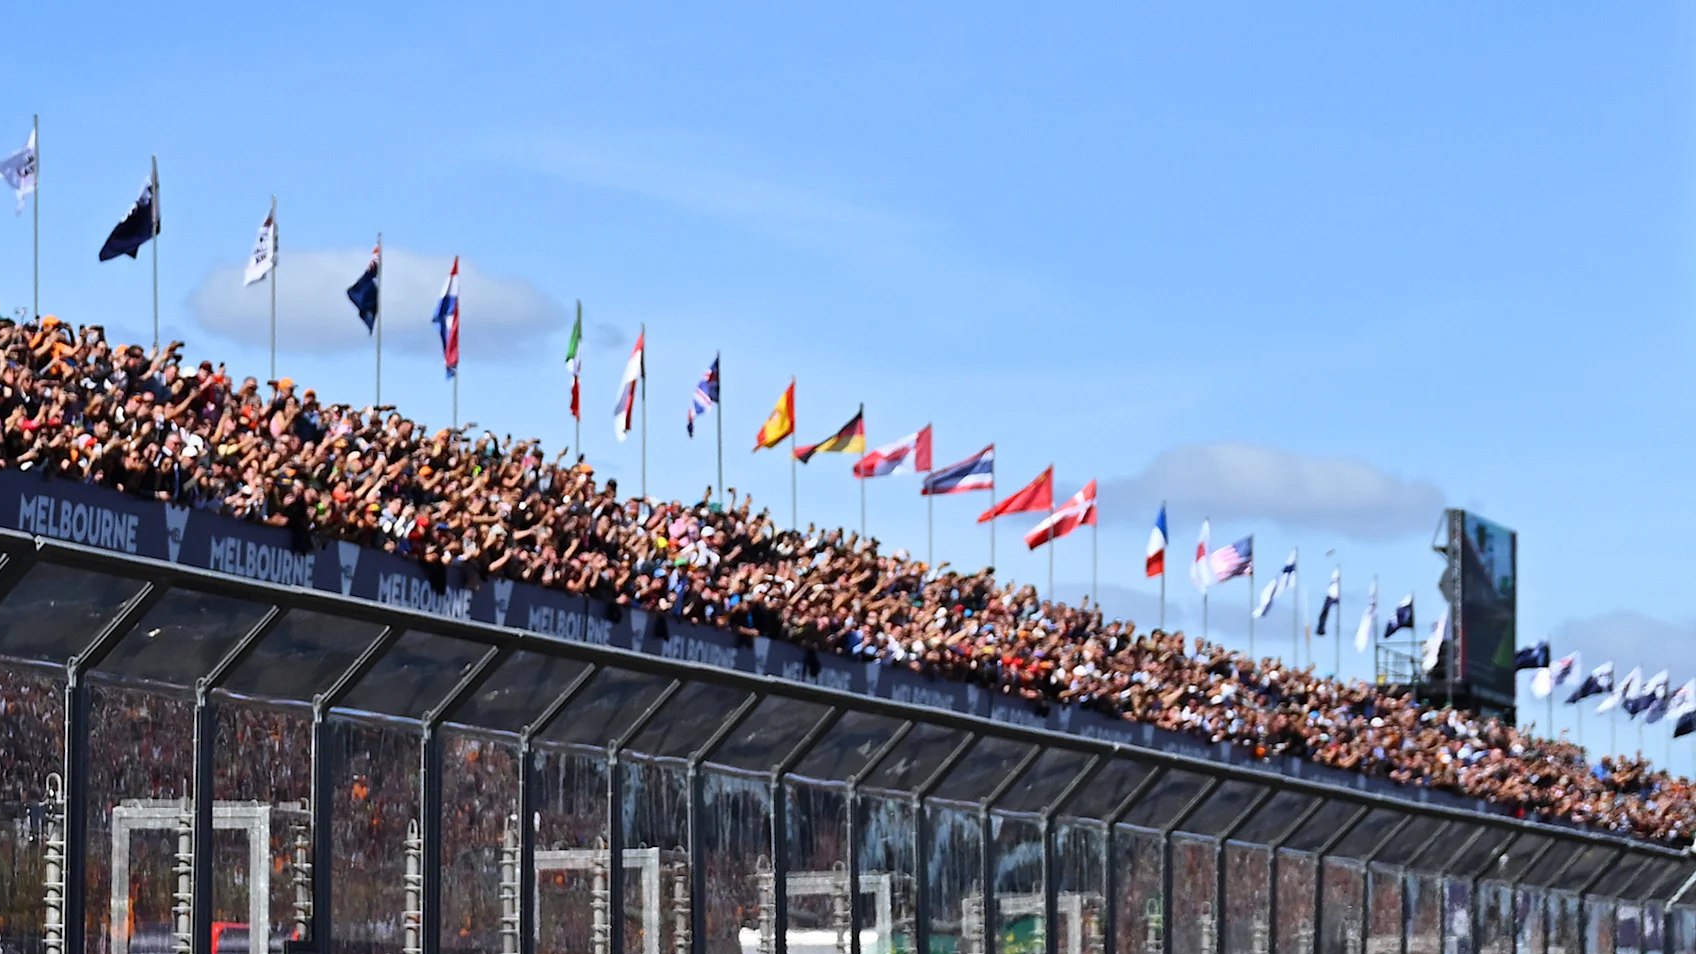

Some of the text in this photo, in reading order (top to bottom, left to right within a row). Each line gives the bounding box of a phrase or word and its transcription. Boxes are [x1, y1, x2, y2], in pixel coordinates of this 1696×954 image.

[19, 493, 139, 553] MELBOURNE
[210, 535, 315, 588] MELBOURNE
[377, 572, 473, 620] MELBOURNE
[528, 604, 613, 645] MELBOURNE
